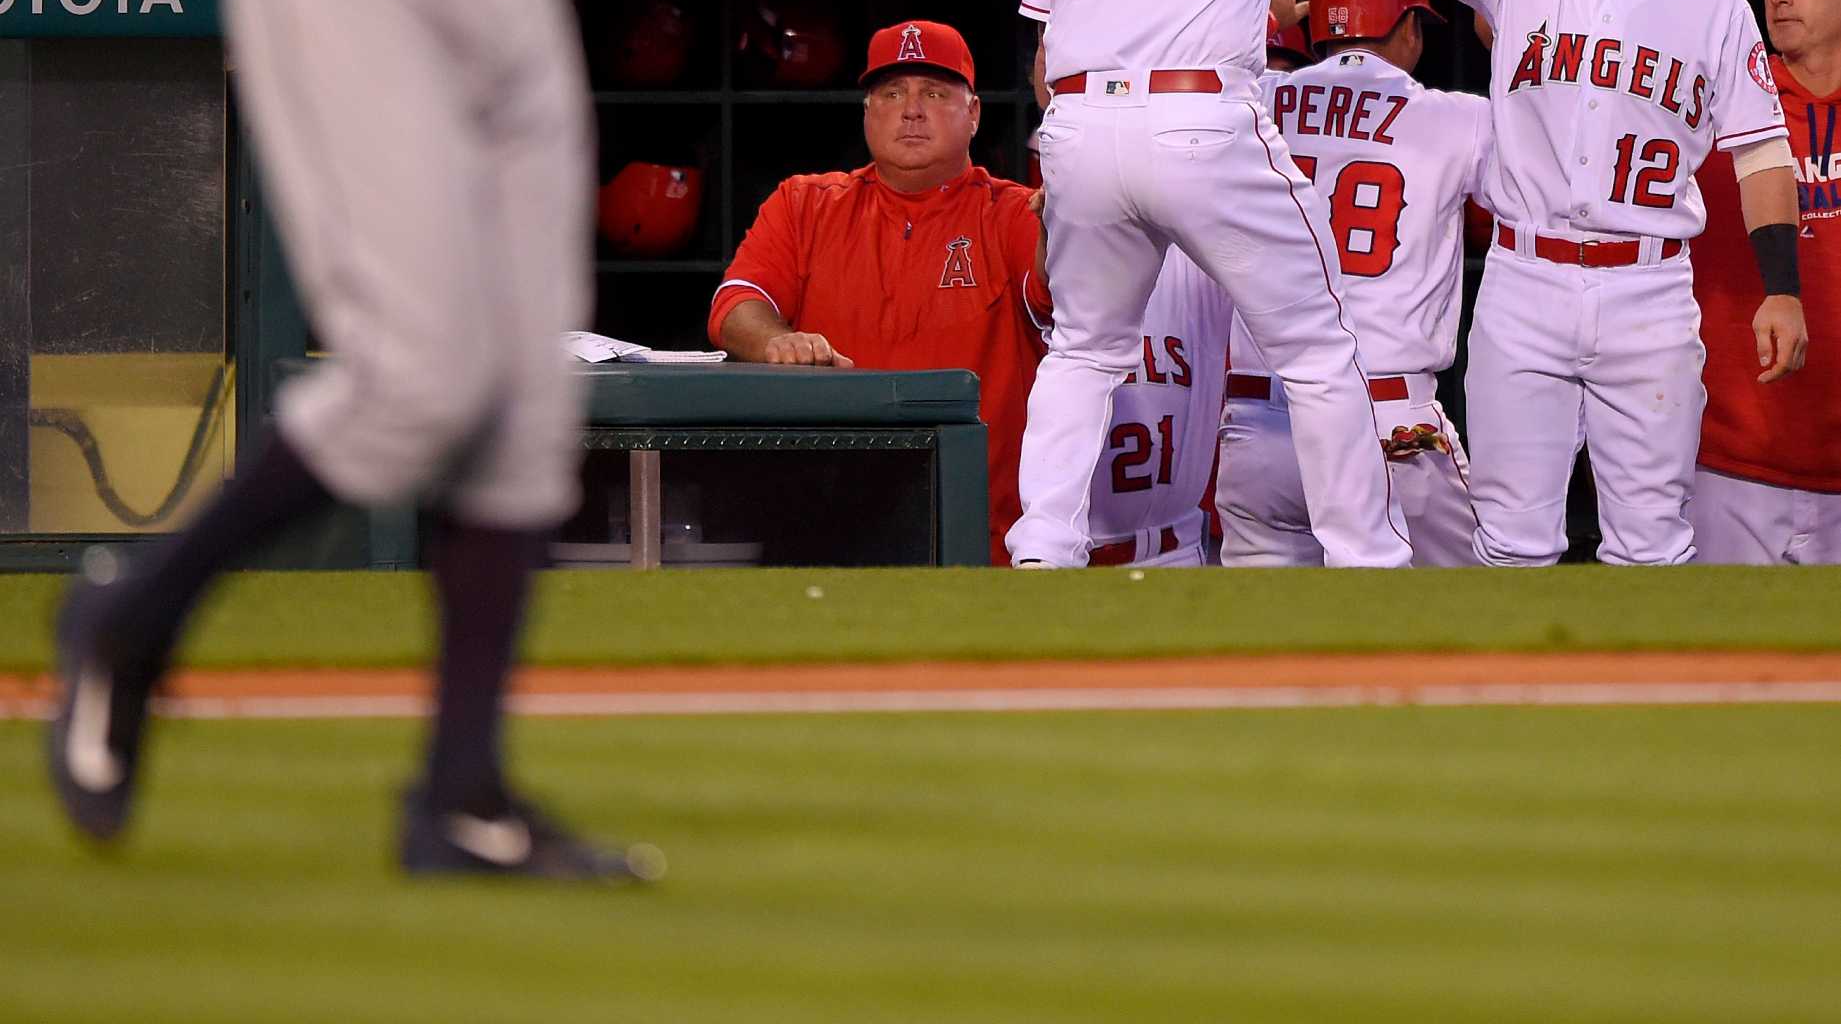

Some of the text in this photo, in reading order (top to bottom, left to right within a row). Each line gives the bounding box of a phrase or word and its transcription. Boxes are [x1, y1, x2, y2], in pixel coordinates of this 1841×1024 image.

[897, 24, 926, 61] A
[1508, 19, 1707, 130] ANGELS
[1274, 84, 1409, 146] PEREZ
[1608, 133, 1681, 210] 12
[1290, 154, 1408, 278] 8
[937, 234, 977, 289] A
[1122, 335, 1193, 388] LS
[1109, 414, 1175, 494] 21
